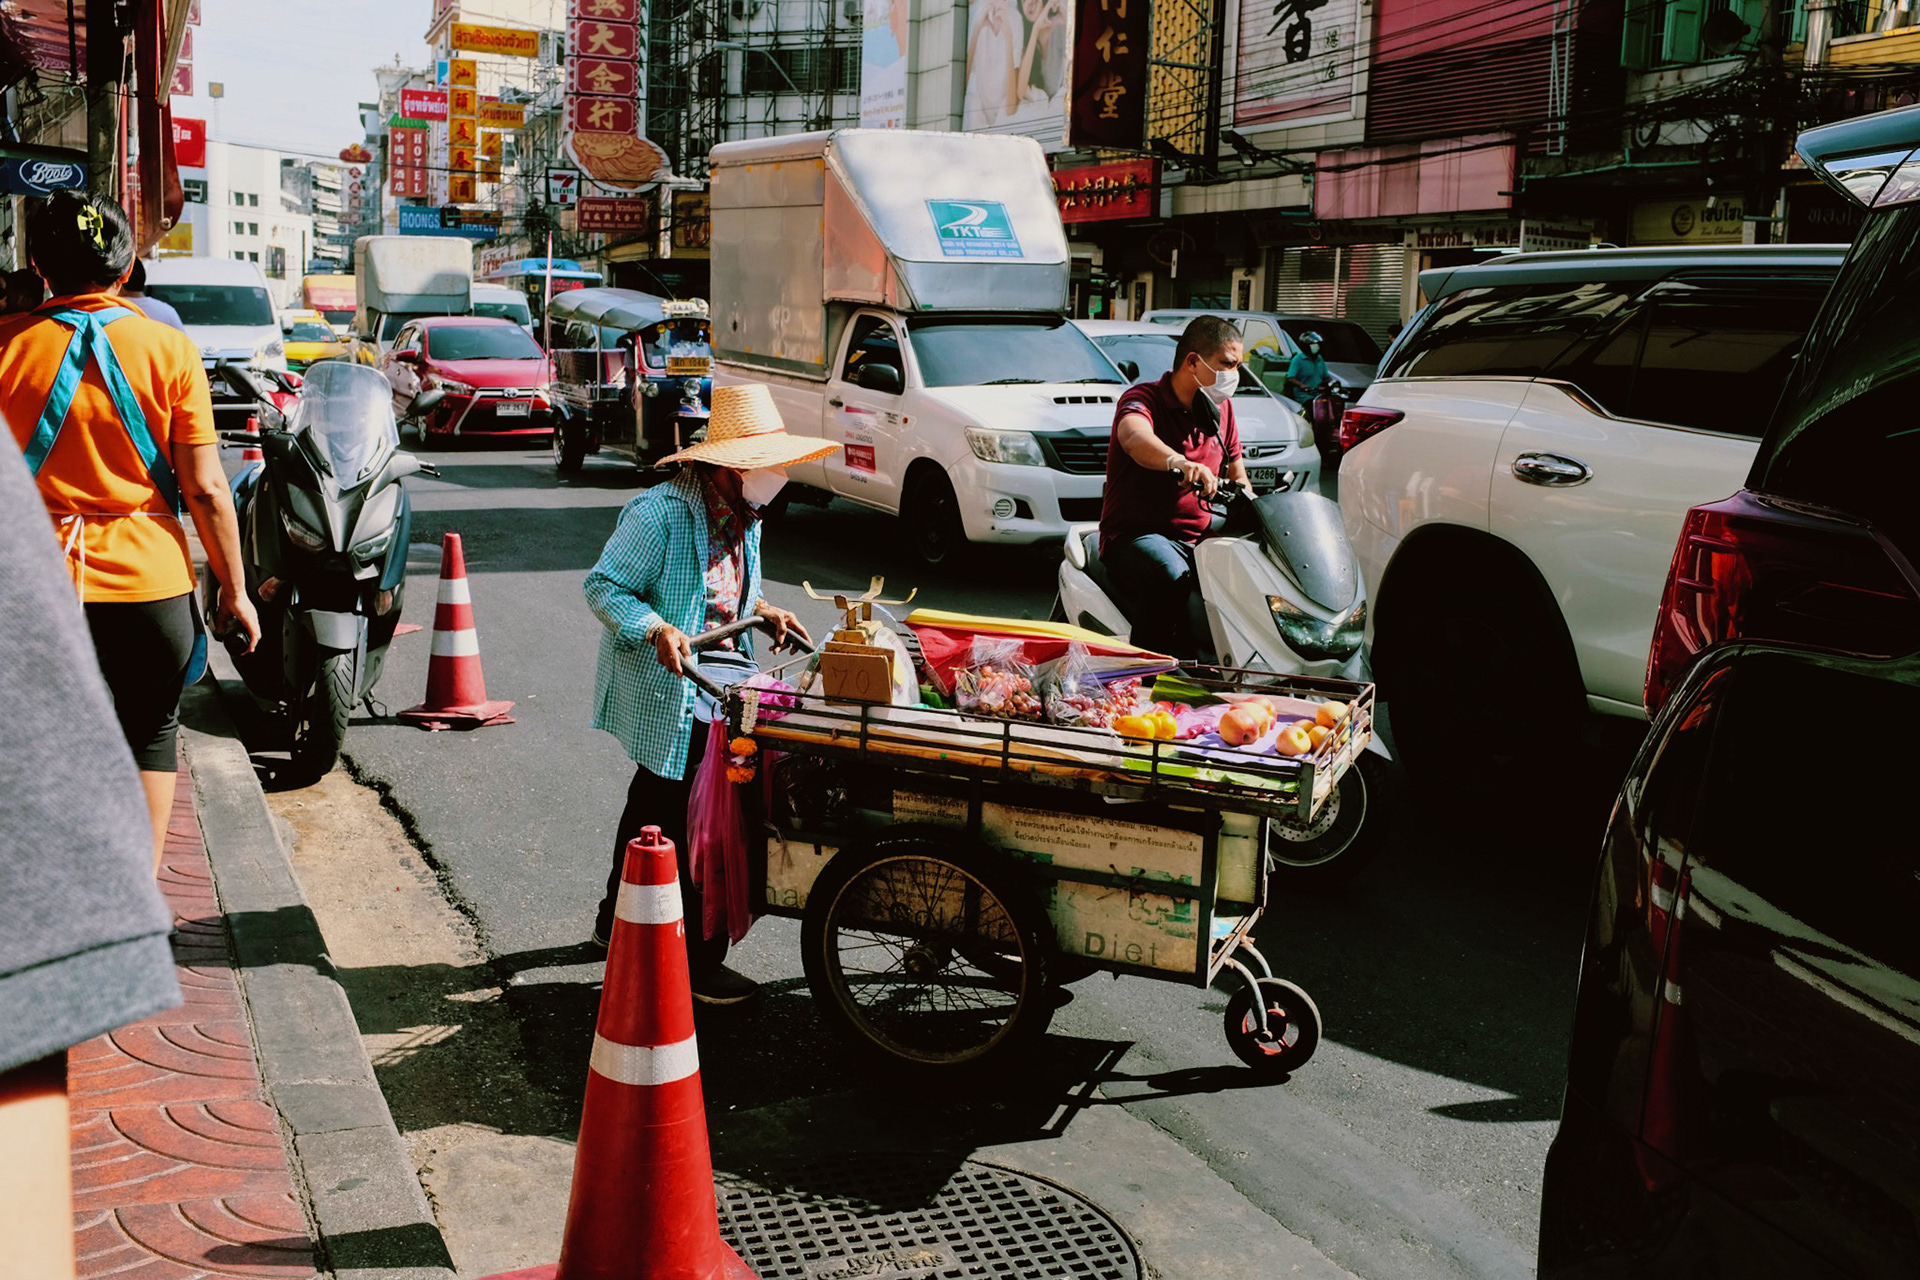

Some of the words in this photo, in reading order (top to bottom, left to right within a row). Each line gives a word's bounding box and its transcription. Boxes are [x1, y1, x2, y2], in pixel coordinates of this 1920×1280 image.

[29, 162, 73, 184] Boots
[413, 133, 423, 193] HOTEL
[949, 226, 981, 237] TKT
[1255, 470, 1275, 479] 4266
[1084, 931, 1159, 966] Diet
